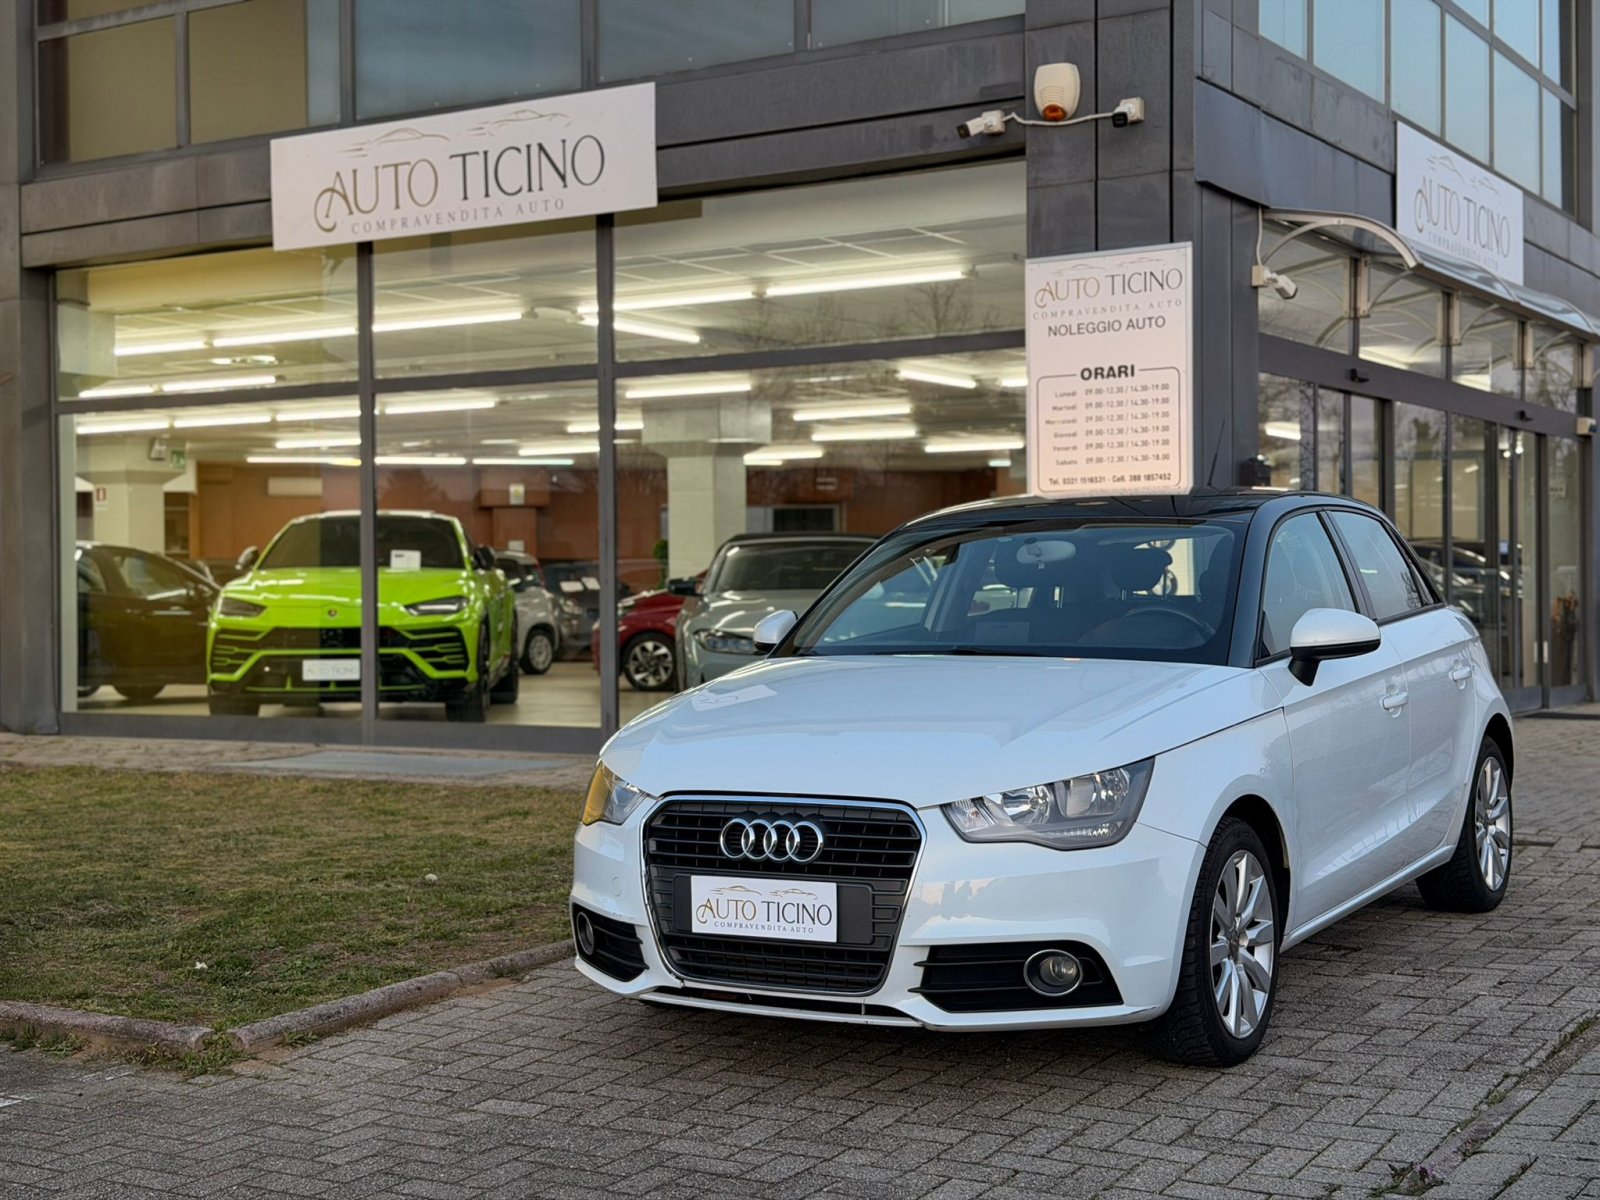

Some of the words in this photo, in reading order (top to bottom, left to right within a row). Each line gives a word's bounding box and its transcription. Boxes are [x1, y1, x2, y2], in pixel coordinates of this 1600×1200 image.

[314, 157, 439, 233] AUTO
[449, 134, 606, 201] TICINO
[351, 206, 503, 235] COMPRAVENDITA
[515, 198, 566, 217] AUTO
[1413, 176, 1461, 236] AUTO
[1463, 195, 1511, 258] TICINO
[1034, 277, 1101, 309] AUTO
[1105, 268, 1183, 296] TICINO
[1033, 304, 1140, 320] COMPRAVENDITA
[1149, 299, 1182, 310] AUTO
[1048, 319, 1122, 337] NOLEGGIO
[1126, 315, 1166, 331] AUTO
[1080, 364, 1135, 381] ORARI
[696, 898, 757, 924] AUTO
[761, 900, 832, 926] TICINO
[714, 921, 787, 932] COMPRAVENDITA
[790, 926, 814, 934] AUTO
